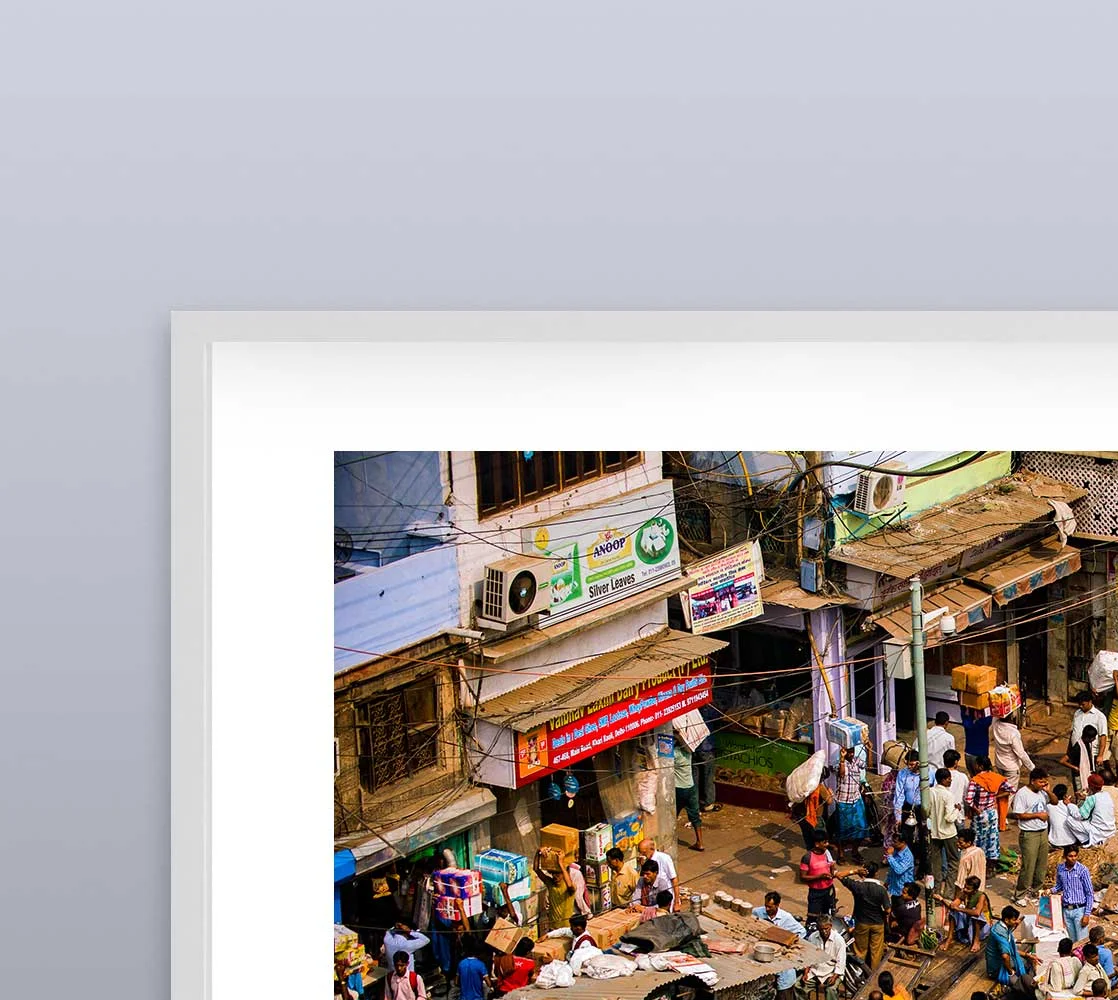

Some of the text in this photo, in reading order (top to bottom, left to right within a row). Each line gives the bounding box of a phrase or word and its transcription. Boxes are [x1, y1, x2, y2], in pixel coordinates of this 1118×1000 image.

[593, 537, 626, 558] ANOOP
[588, 572, 637, 599] Silver Leaves
